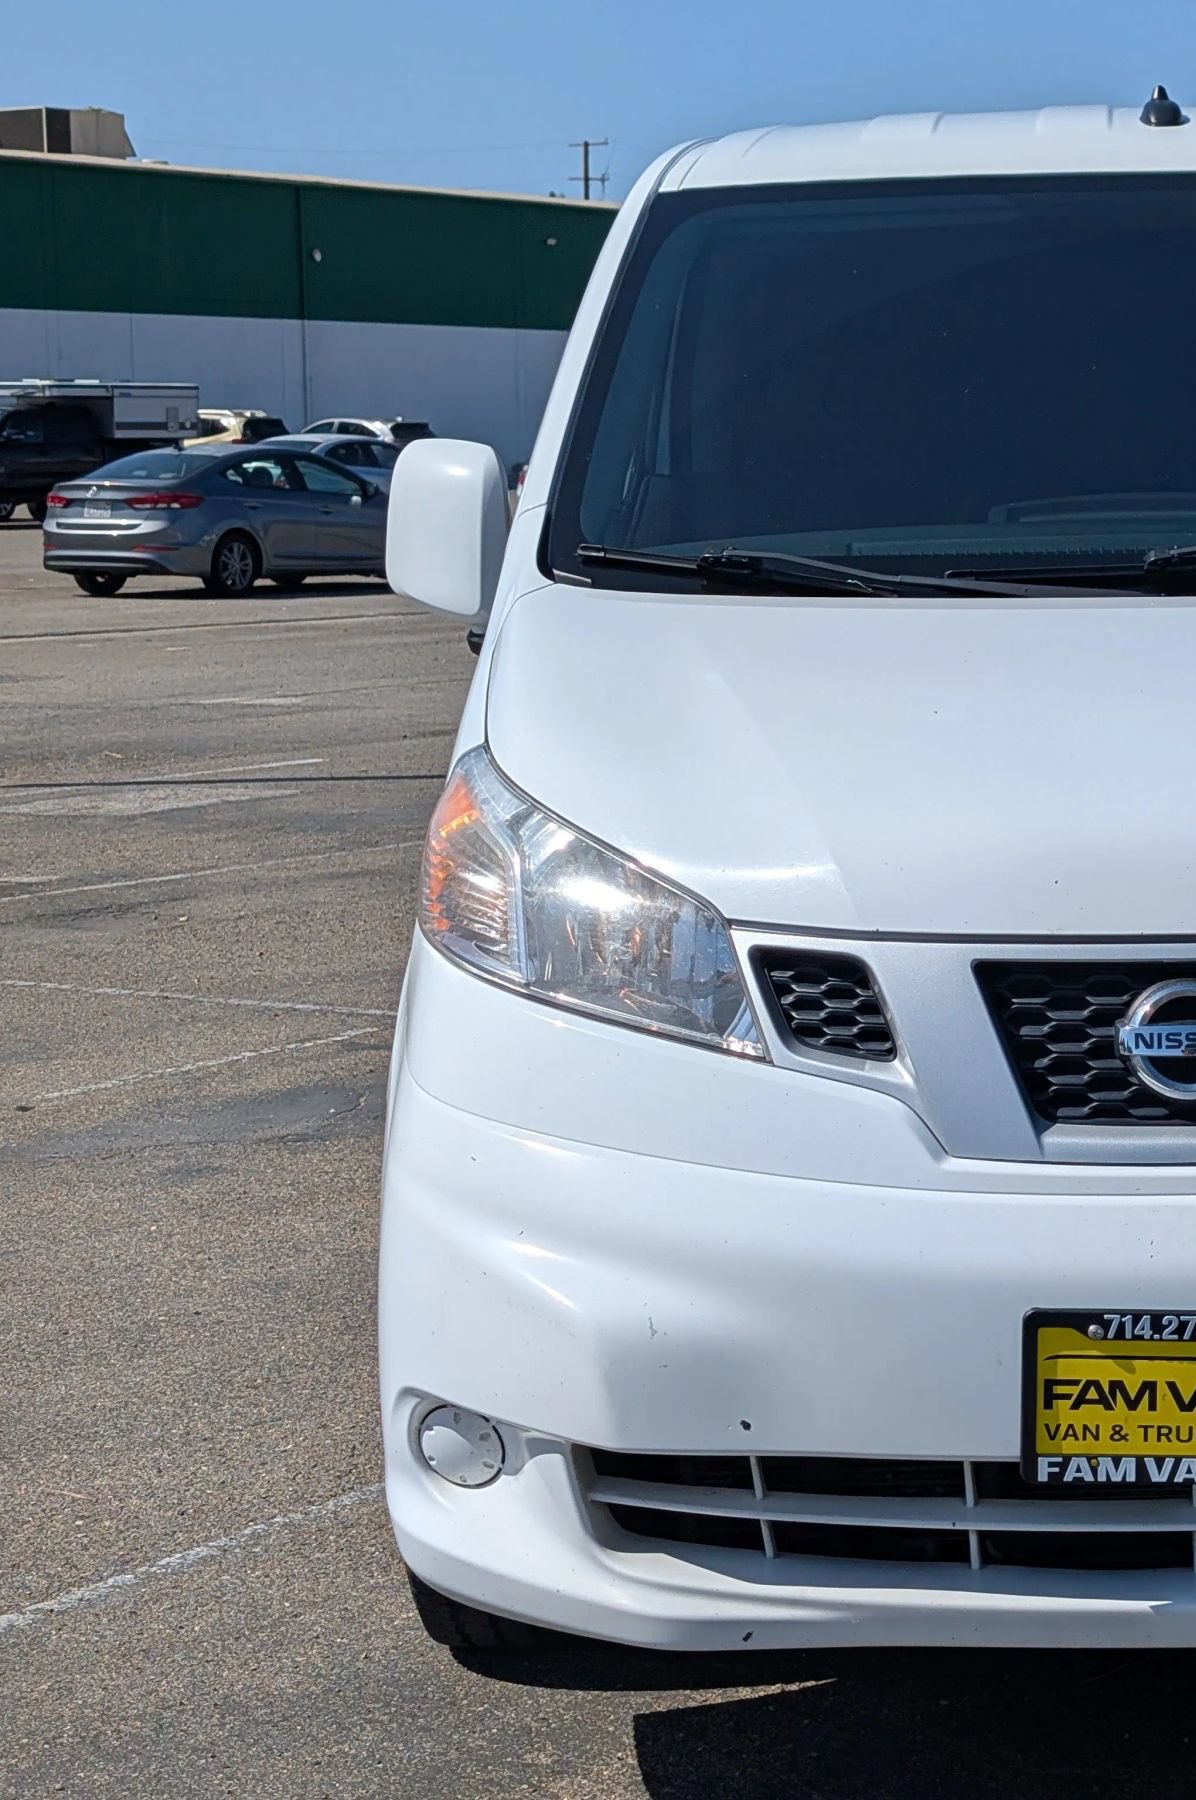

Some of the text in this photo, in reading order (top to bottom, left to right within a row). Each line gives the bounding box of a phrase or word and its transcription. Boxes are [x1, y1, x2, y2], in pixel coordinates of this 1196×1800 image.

[1043, 1378, 1158, 1411] FAM
[1044, 1423, 1101, 1442] VAN
[1109, 1423, 1130, 1442] &
[1037, 1456, 1137, 1482] FAM
